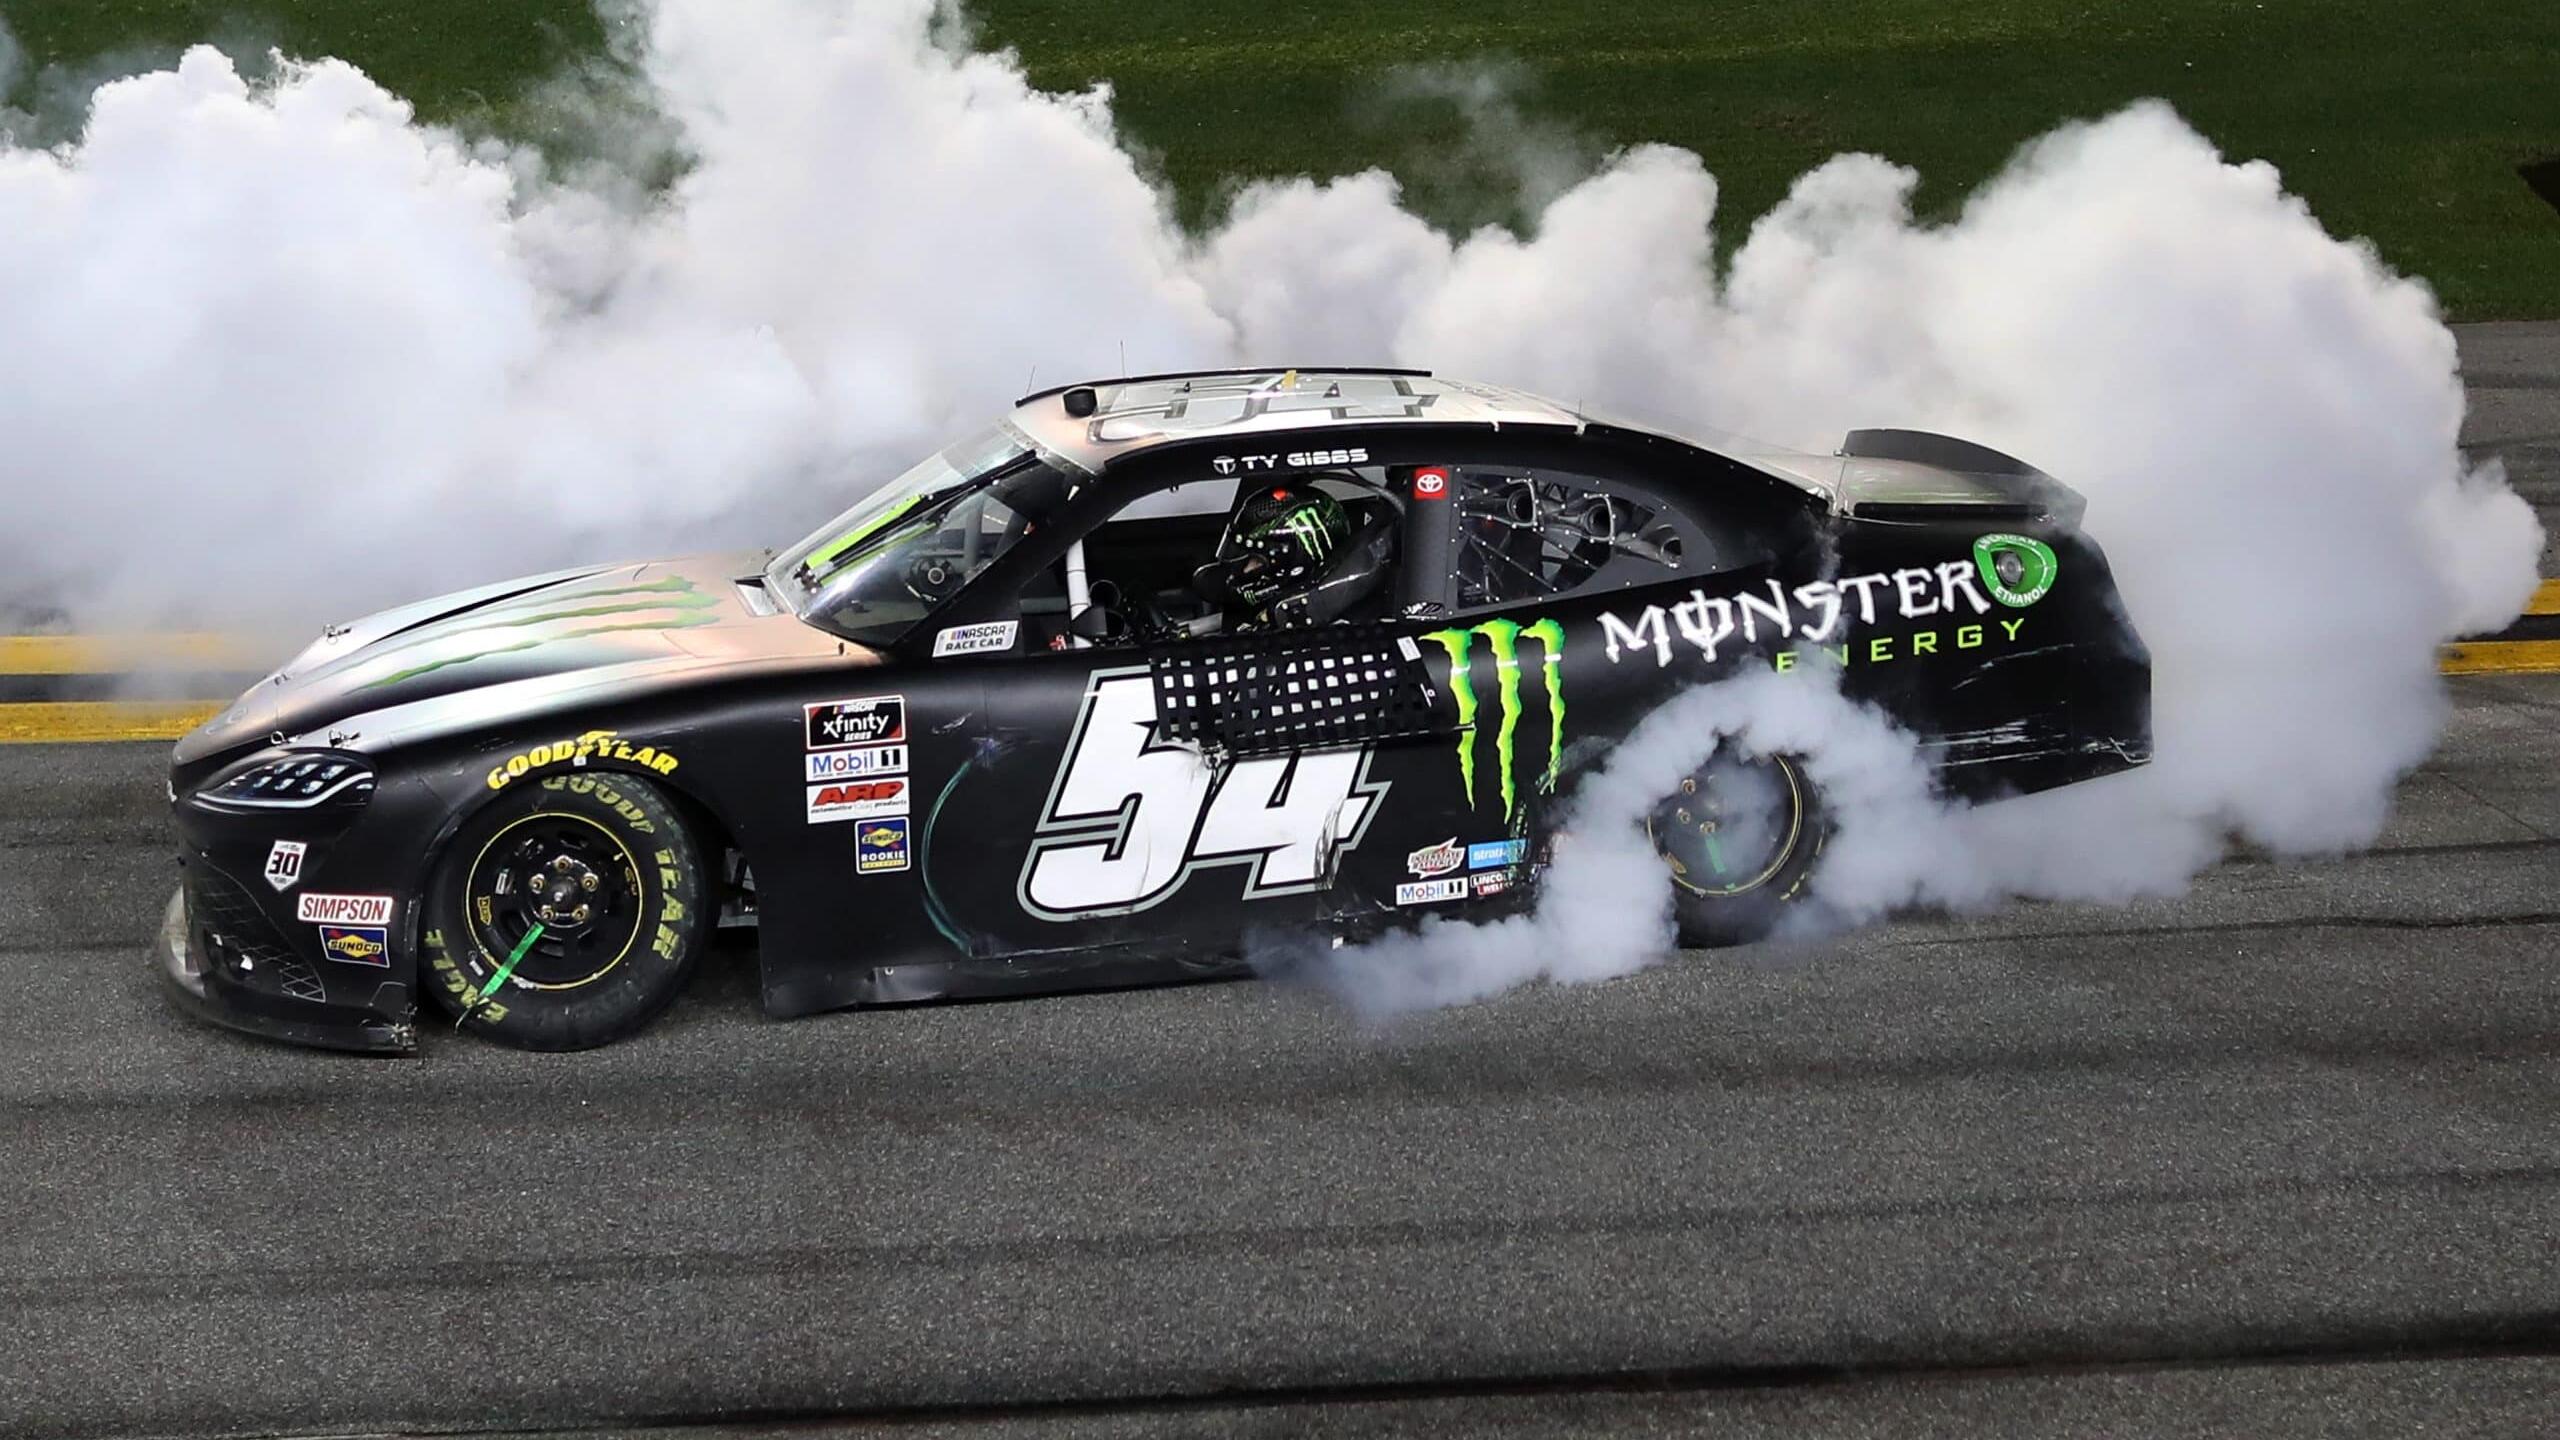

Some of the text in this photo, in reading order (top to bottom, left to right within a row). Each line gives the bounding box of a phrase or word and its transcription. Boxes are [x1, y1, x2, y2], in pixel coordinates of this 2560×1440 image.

[1241, 454, 1278, 470] TY
[1995, 585, 2047, 604] ETHANOL
[1597, 559, 1991, 667] MONSTER
[955, 625, 1006, 641] NASCAR
[945, 638, 1003, 652] RACE CAR
[823, 712, 889, 738] xfinity
[487, 732, 679, 791] GOODYEAR
[812, 751, 874, 774] Mobil
[812, 781, 905, 806] ARP
[1016, 664, 1393, 923] 54
[268, 851, 301, 876] 30
[861, 850, 905, 862] ROOKIE
[1402, 883, 1444, 900] Mobil
[302, 897, 386, 921] SIMPSON
[329, 940, 381, 953] SUNOCO
